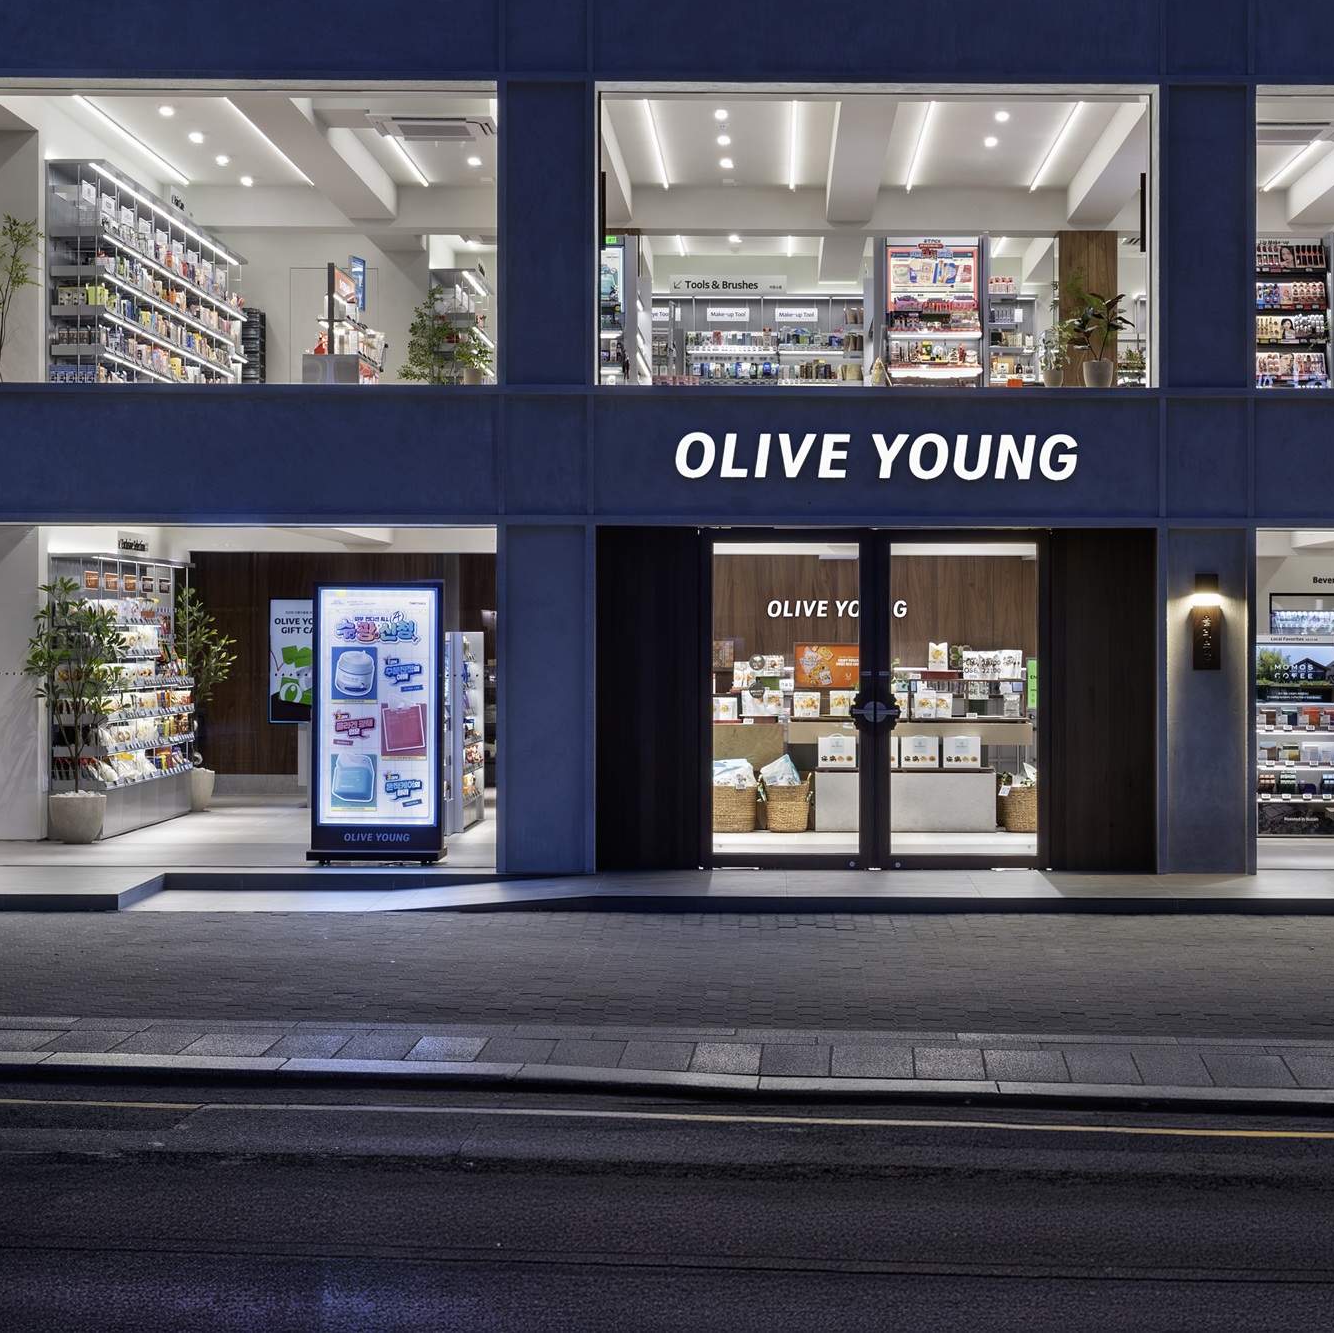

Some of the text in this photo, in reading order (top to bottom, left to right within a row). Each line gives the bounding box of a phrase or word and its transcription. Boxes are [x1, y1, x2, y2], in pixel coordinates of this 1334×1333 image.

[685, 280, 758, 289] Tools & Brushes
[675, 432, 1078, 481] OLIVE YOUNG
[767, 600, 908, 618] OLIVE YOG
[274, 617, 300, 625] OLIVE
[281, 626, 301, 634] GIFT
[344, 833, 410, 842] OLIVE YOUNG
